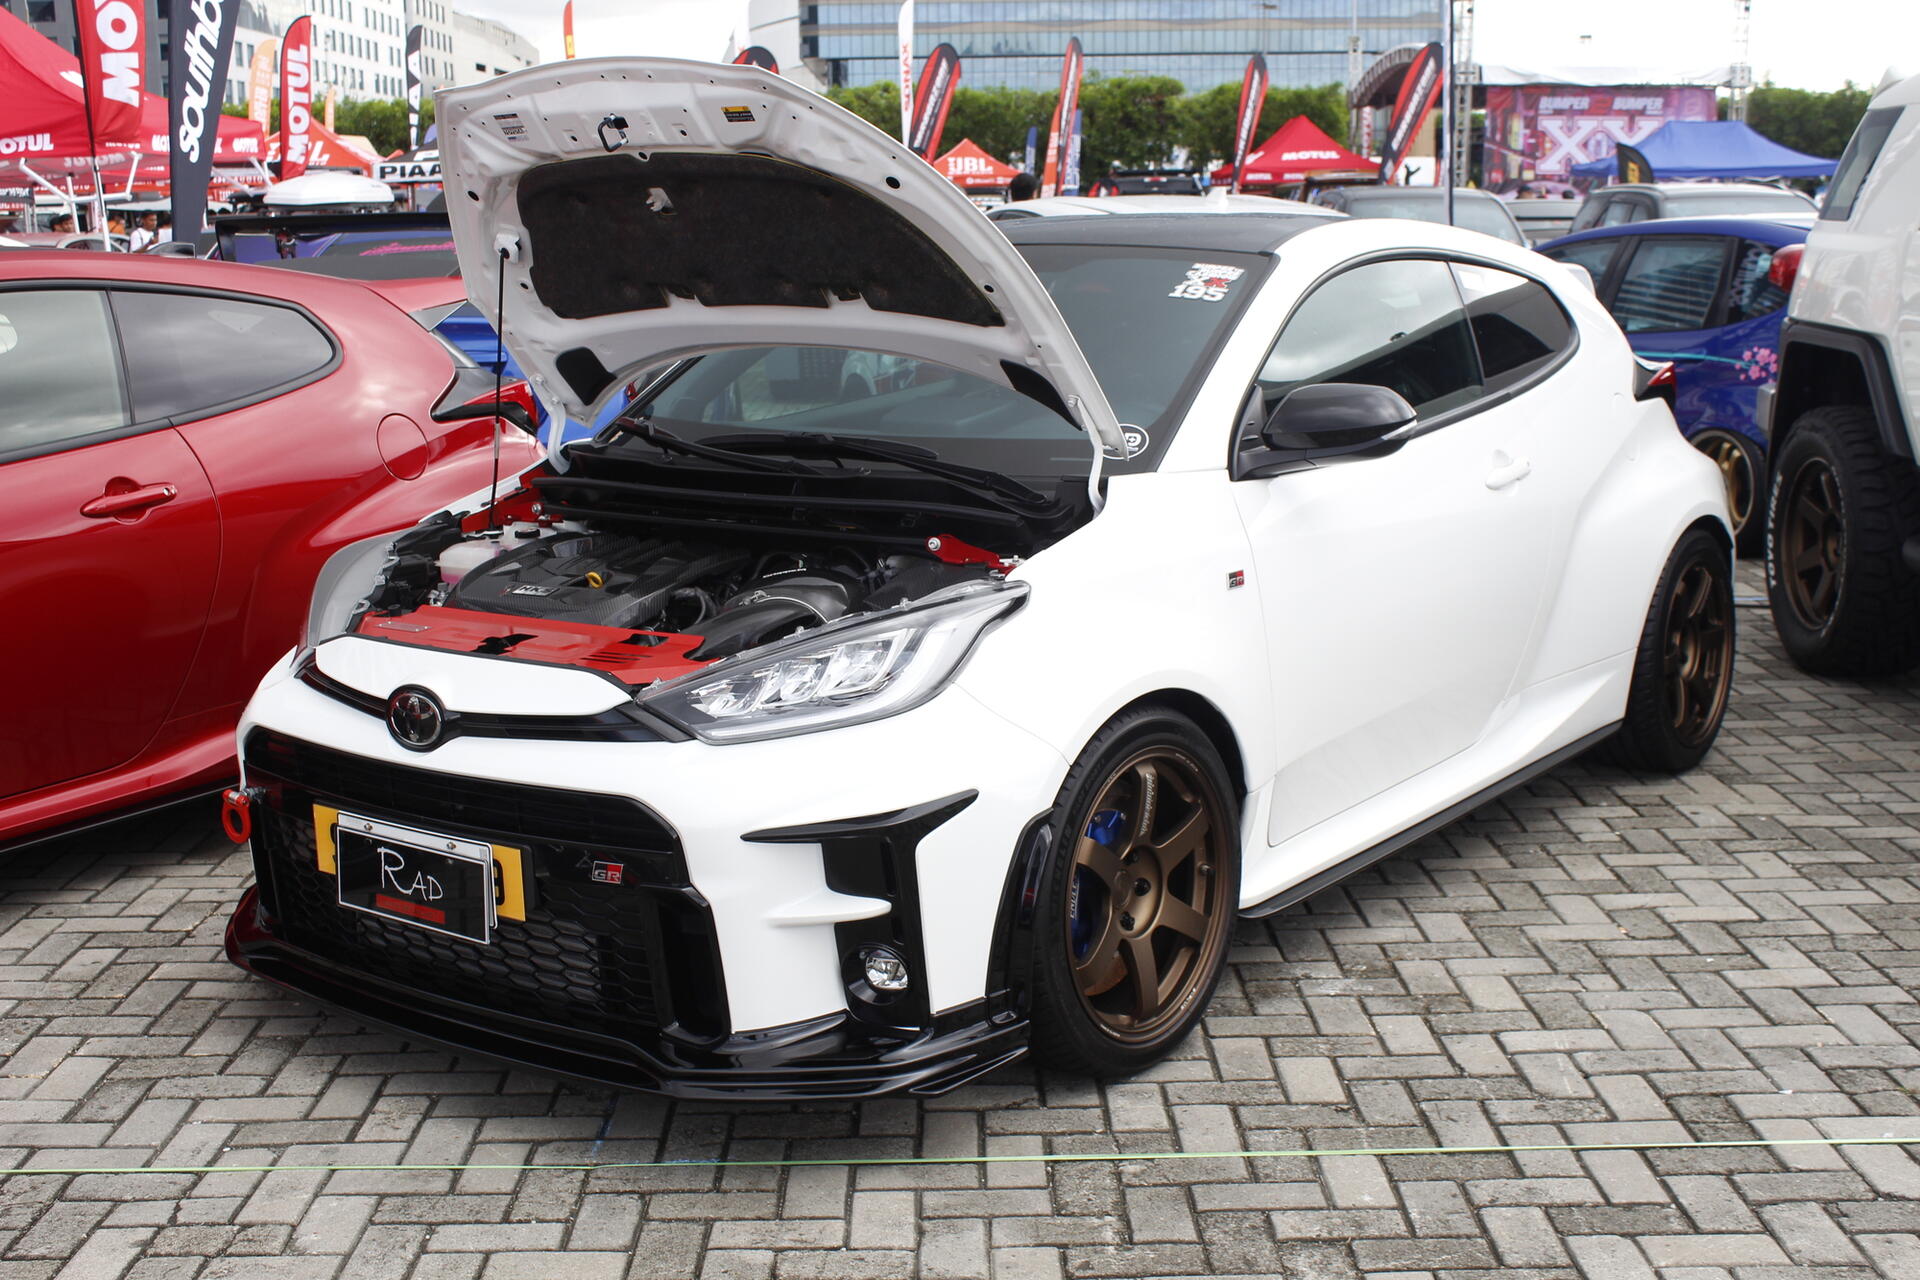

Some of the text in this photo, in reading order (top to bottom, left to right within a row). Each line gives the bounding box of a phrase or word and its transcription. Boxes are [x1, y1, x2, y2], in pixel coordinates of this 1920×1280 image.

[95, 0, 140, 108] MO
[287, 43, 309, 164] MOTUL
[1539, 96, 1590, 111] BUMPER
[1612, 97, 1664, 111] BUMPER
[0, 133, 54, 154] OTUL
[954, 156, 994, 172] JBL
[1281, 150, 1341, 161] MOTUL
[1168, 285, 1230, 302] 195
[1766, 532, 1777, 589] TOYO
[377, 846, 443, 901] RAD
[594, 869, 620, 882] GR
